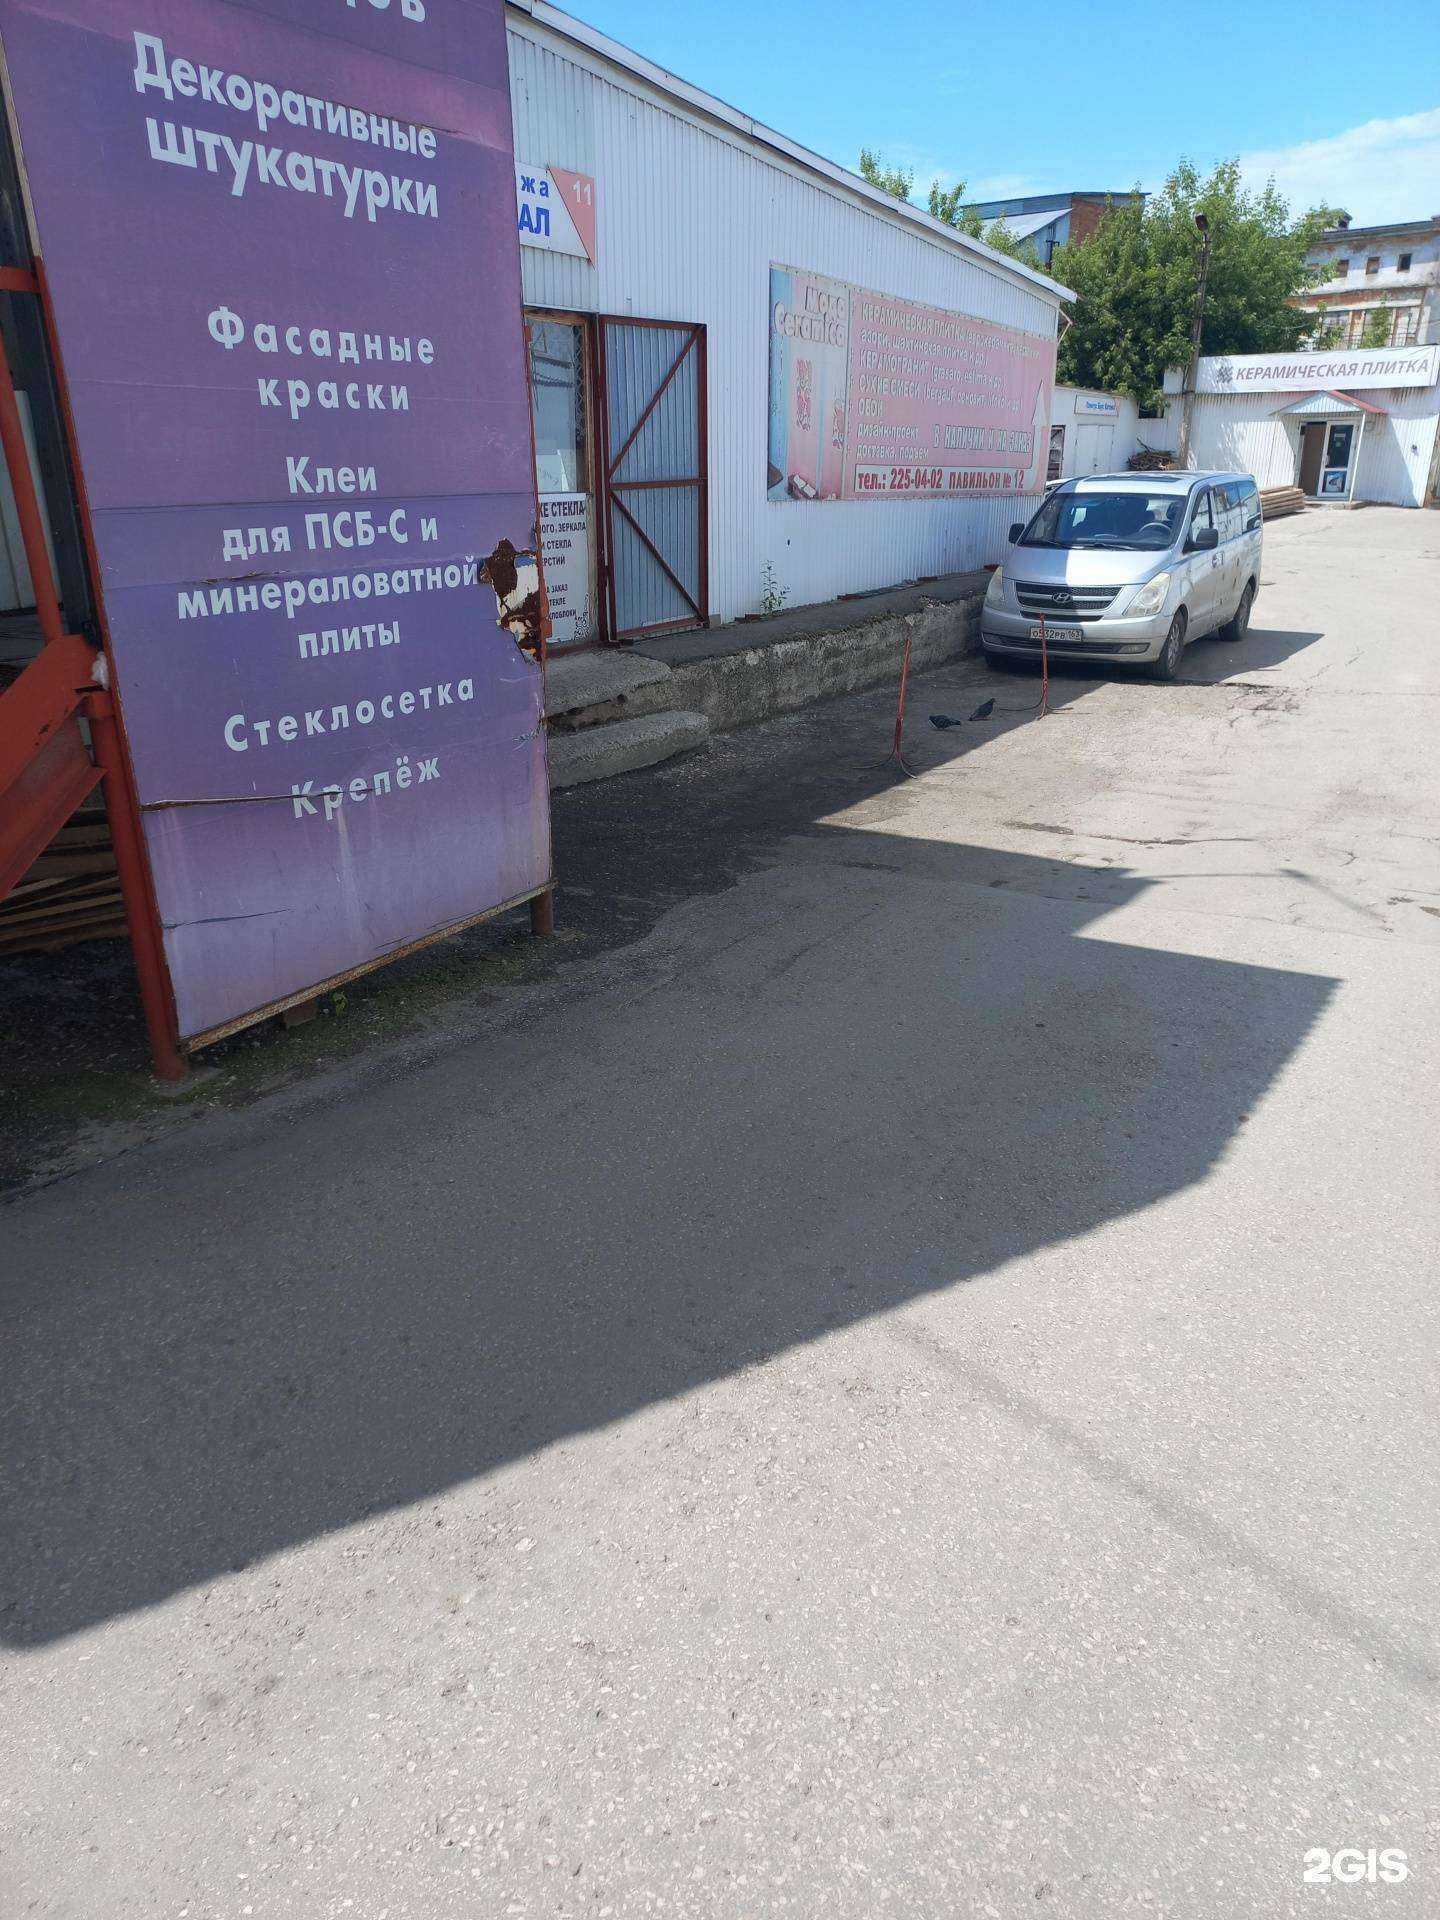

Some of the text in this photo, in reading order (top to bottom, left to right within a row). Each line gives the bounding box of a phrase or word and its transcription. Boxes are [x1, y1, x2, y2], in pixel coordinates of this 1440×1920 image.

[134, 32, 437, 158] Декоративные
[572, 179, 592, 206] 11
[207, 306, 435, 364] Фасадные
[1236, 358, 1428, 380] КЕРАМИЧЕСКАЯ ПЛИТКА
[257, 378, 410, 419] краски
[944, 425, 984, 450] НАЛИЧИИ
[286, 456, 377, 495] Клеи
[889, 468, 942, 489] 225-04-02
[949, 471, 1001, 489] ПАВИЛЬОН
[1002, 475, 1011, 487] №
[1014, 470, 1024, 488] 12
[223, 508, 439, 562] для ПСБ-С и
[546, 539, 572, 550] СТЕКЛА
[558, 521, 586, 532] ЗЕРКАЛА
[178, 556, 480, 619] минераловатной
[551, 583, 569, 593] ЗАКАЗ
[298, 621, 400, 659] плиты
[224, 677, 475, 752] Стеклосетка
[291, 754, 441, 820] Крепёж
